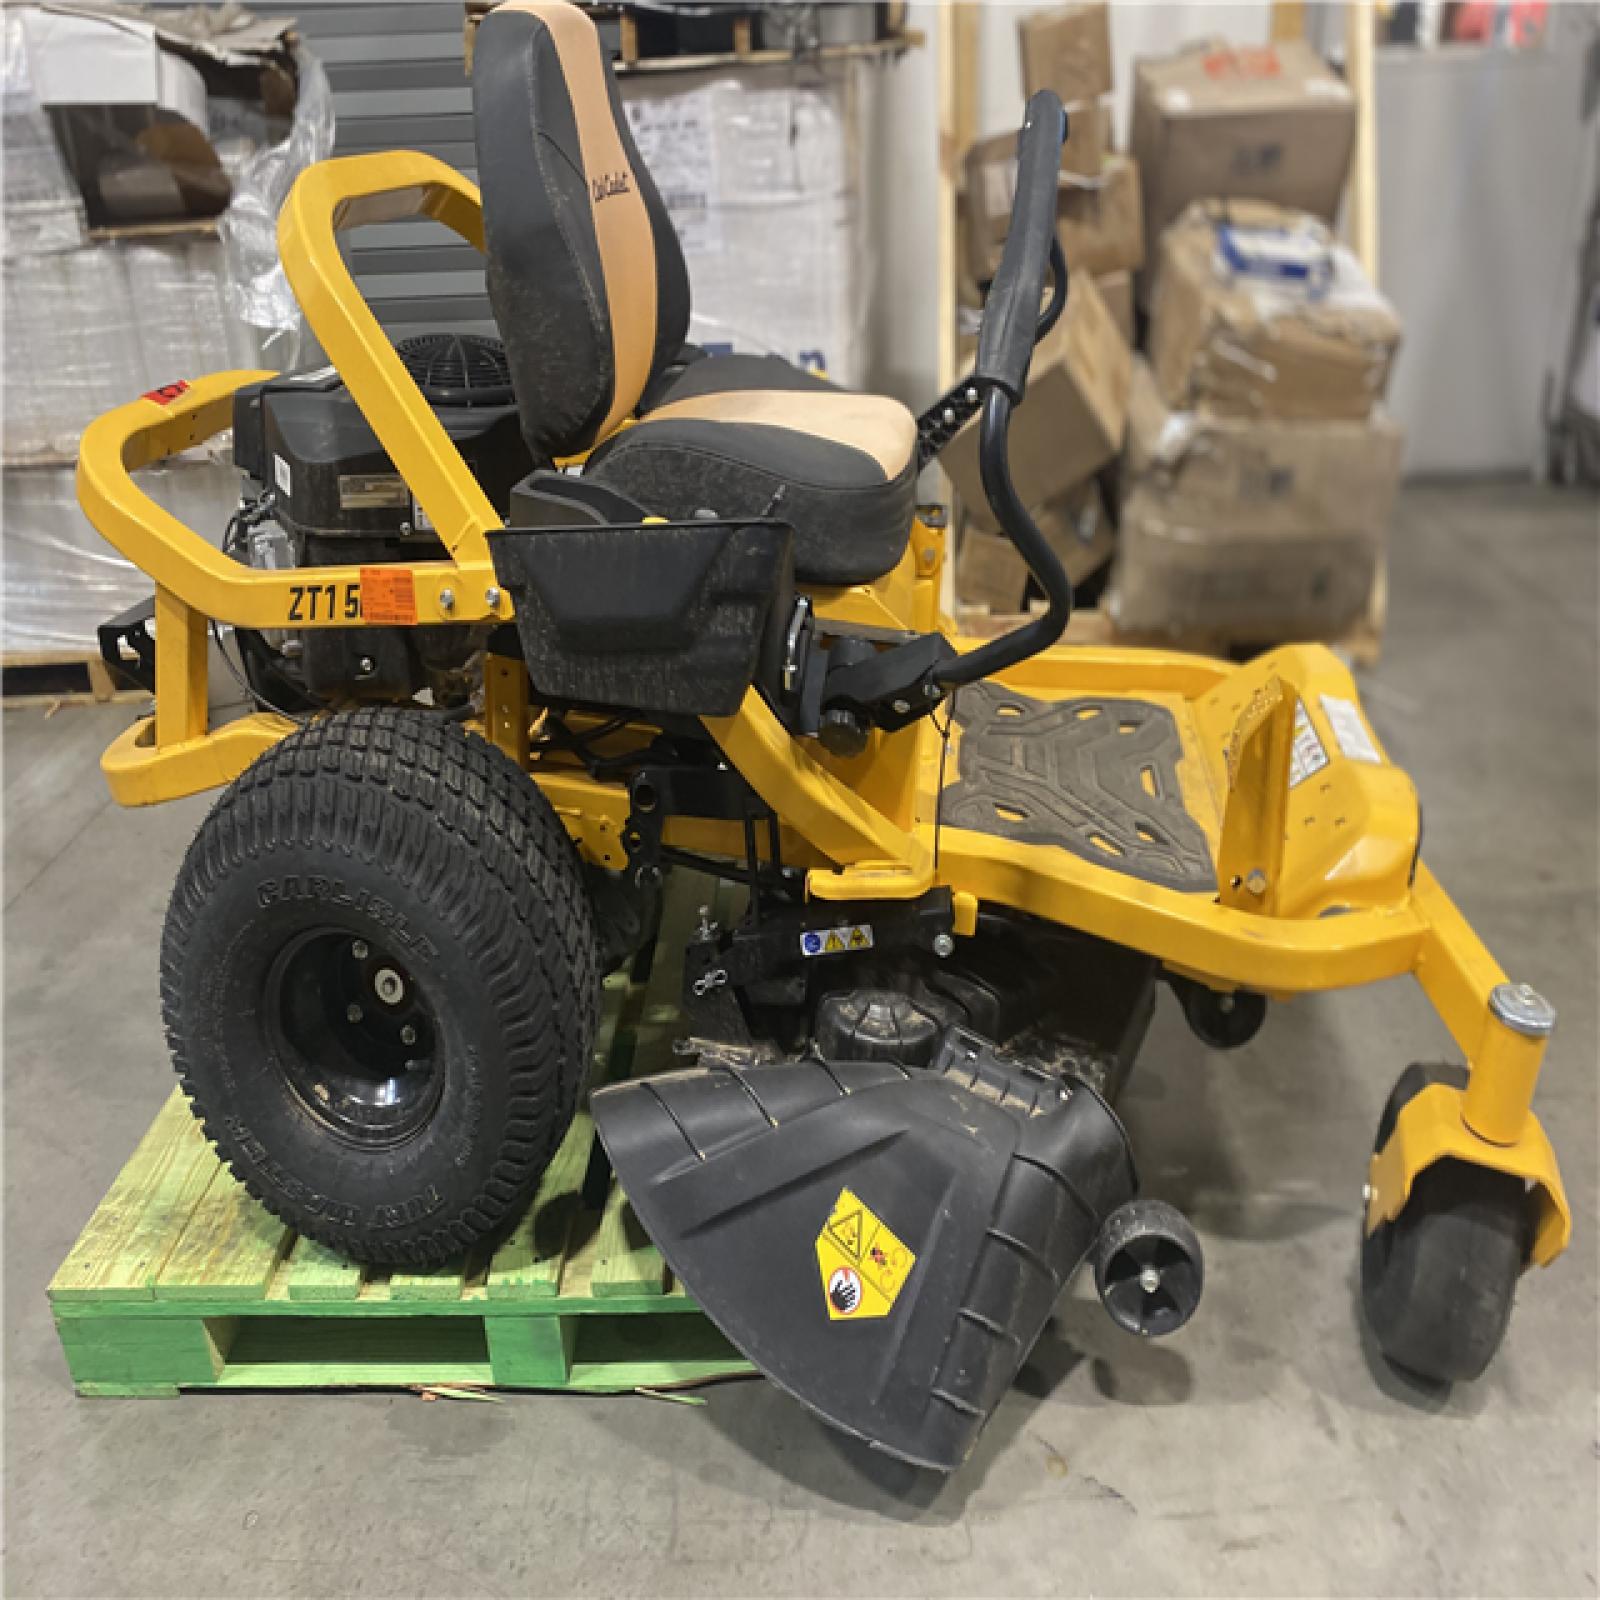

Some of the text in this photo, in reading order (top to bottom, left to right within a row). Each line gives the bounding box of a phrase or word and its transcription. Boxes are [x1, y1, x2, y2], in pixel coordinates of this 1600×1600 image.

[288, 584, 336, 621] ZT1
[344, 584, 363, 619] 5
[257, 874, 440, 963] CARLISLE
